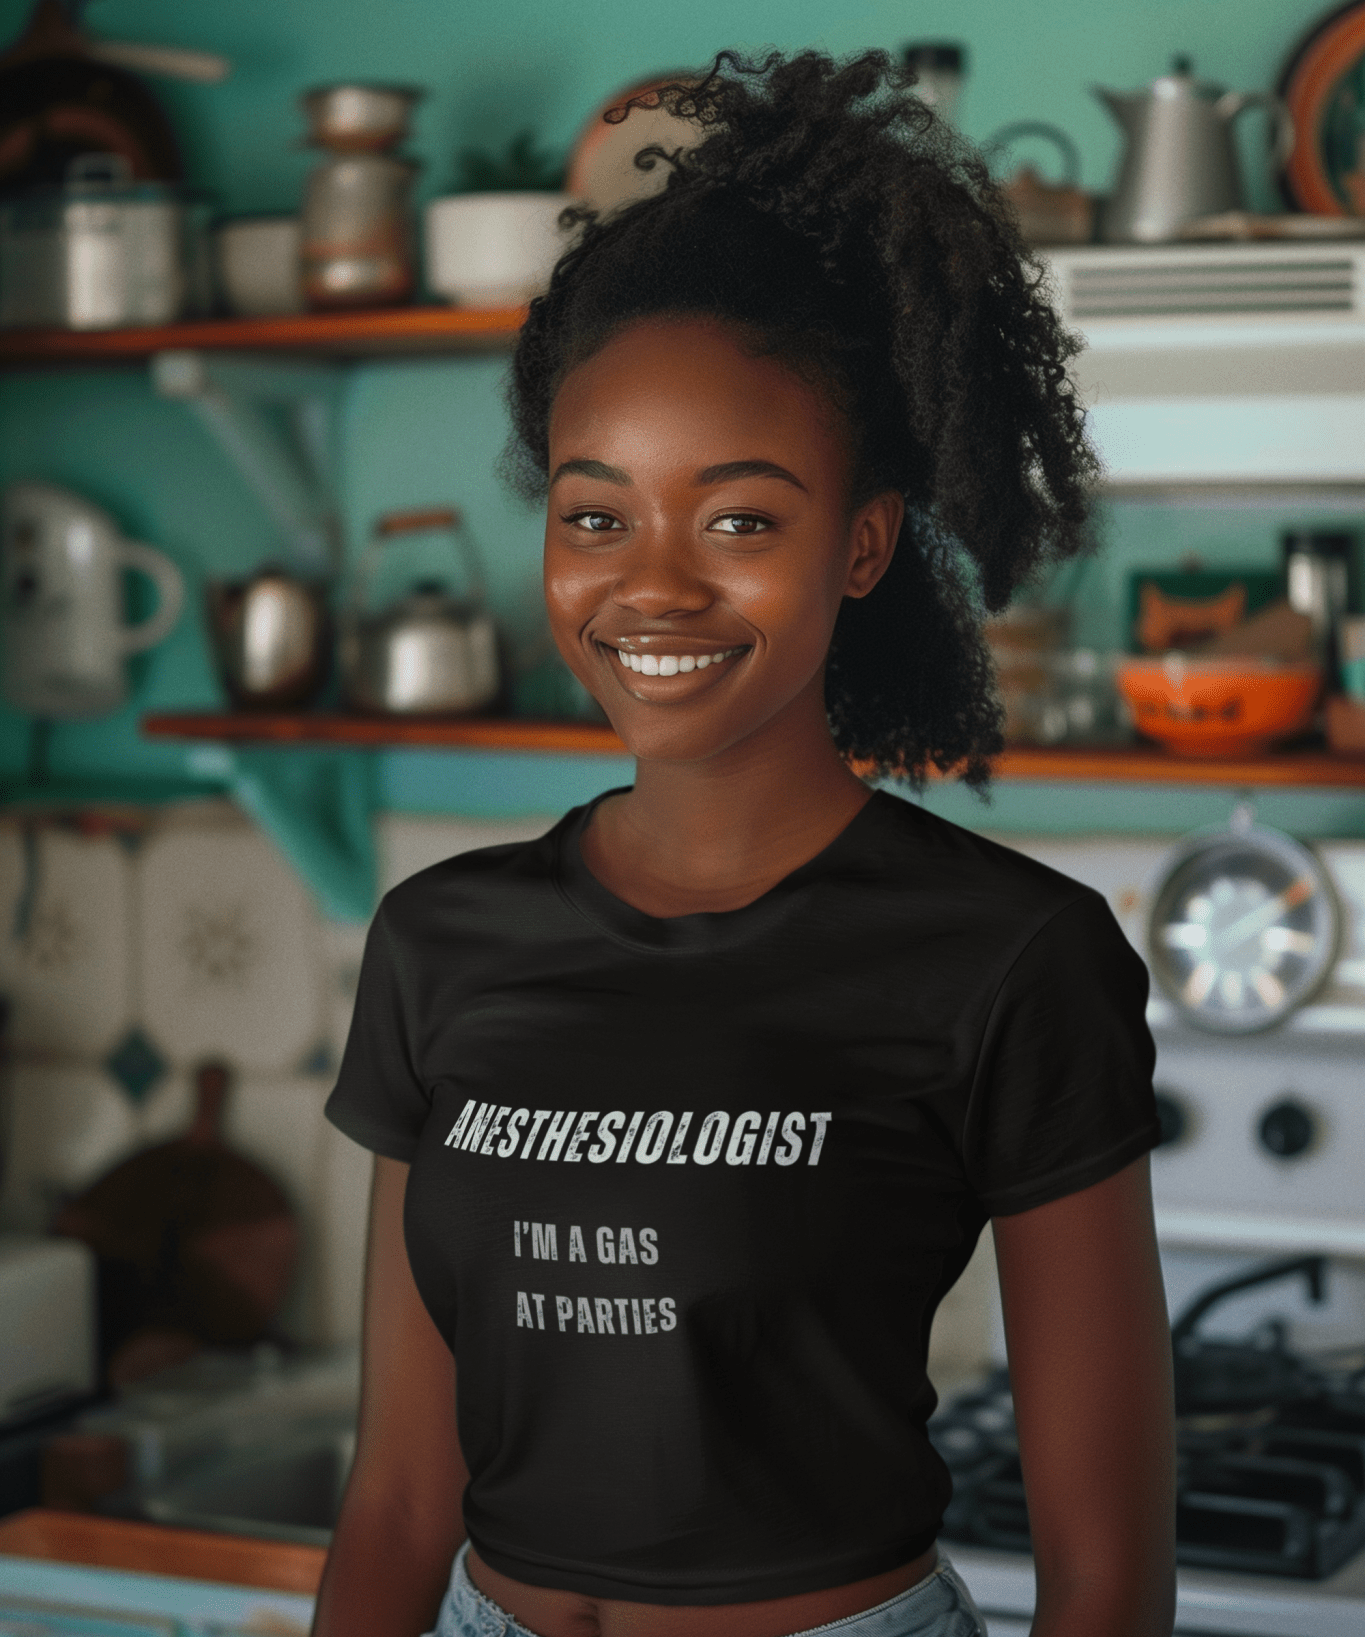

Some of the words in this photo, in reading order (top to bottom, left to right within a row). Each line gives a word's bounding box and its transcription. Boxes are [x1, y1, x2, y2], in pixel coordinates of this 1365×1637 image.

[444, 1099, 832, 1166] ANESTHESIOLOGIST
[513, 1220, 558, 1261] I'M
[568, 1225, 588, 1263] A
[596, 1226, 659, 1265] GAS
[516, 1291, 546, 1330] AT
[555, 1295, 677, 1335] PARTIES
